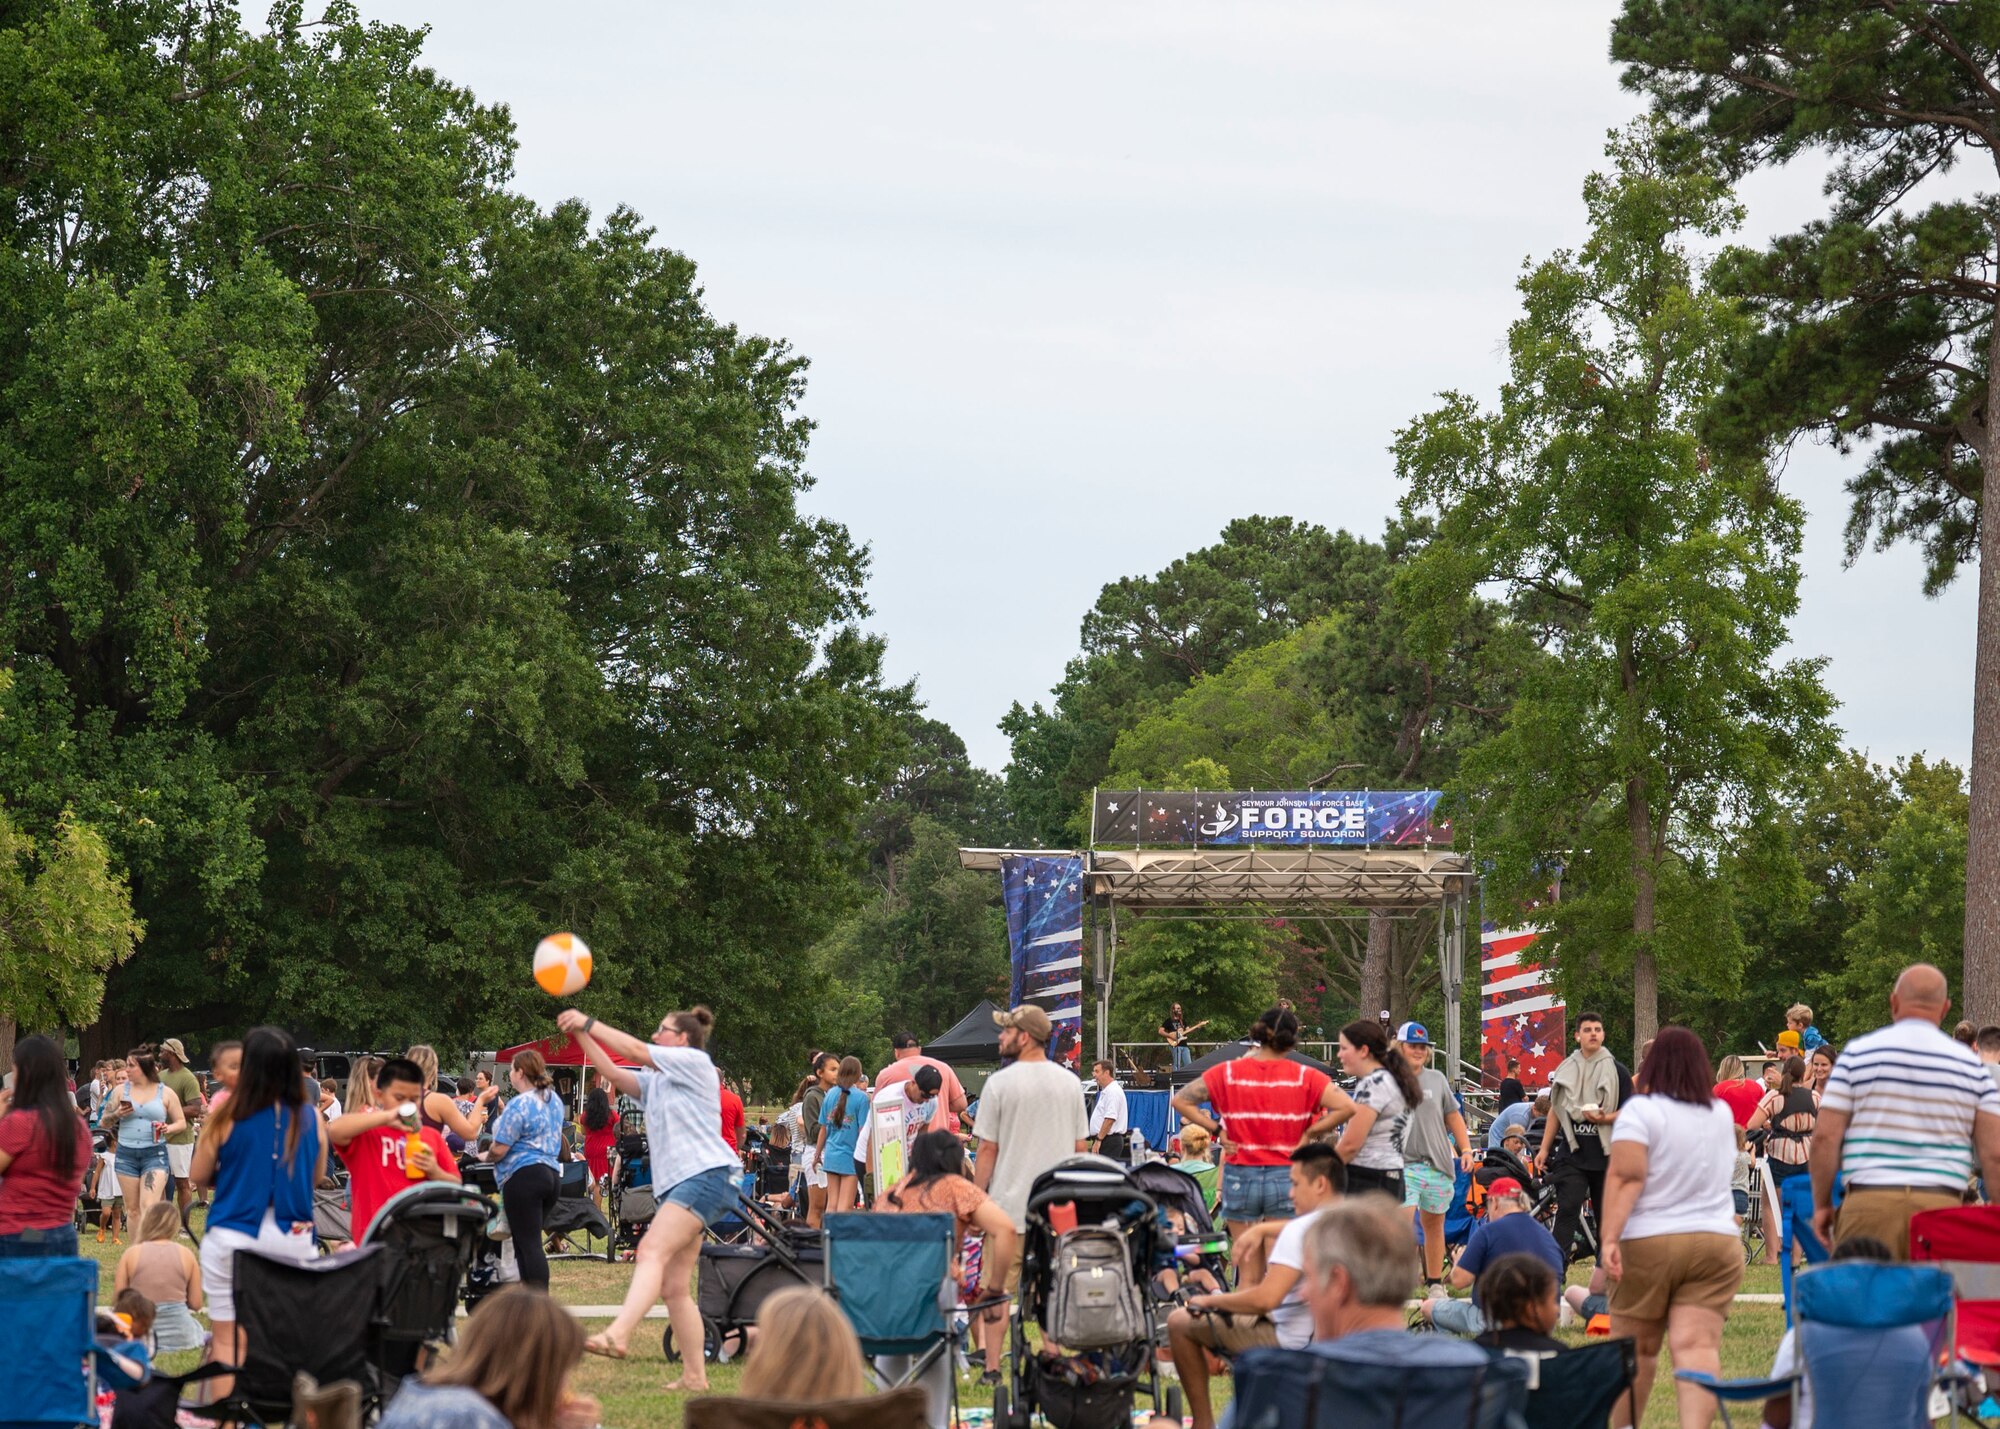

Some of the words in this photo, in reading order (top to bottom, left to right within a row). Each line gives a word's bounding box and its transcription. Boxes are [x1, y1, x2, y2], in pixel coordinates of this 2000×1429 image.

[1242, 808, 1365, 829] FORCE
[1242, 830, 1295, 838] SUPPORT
[1300, 830, 1365, 838] SQUADRON
